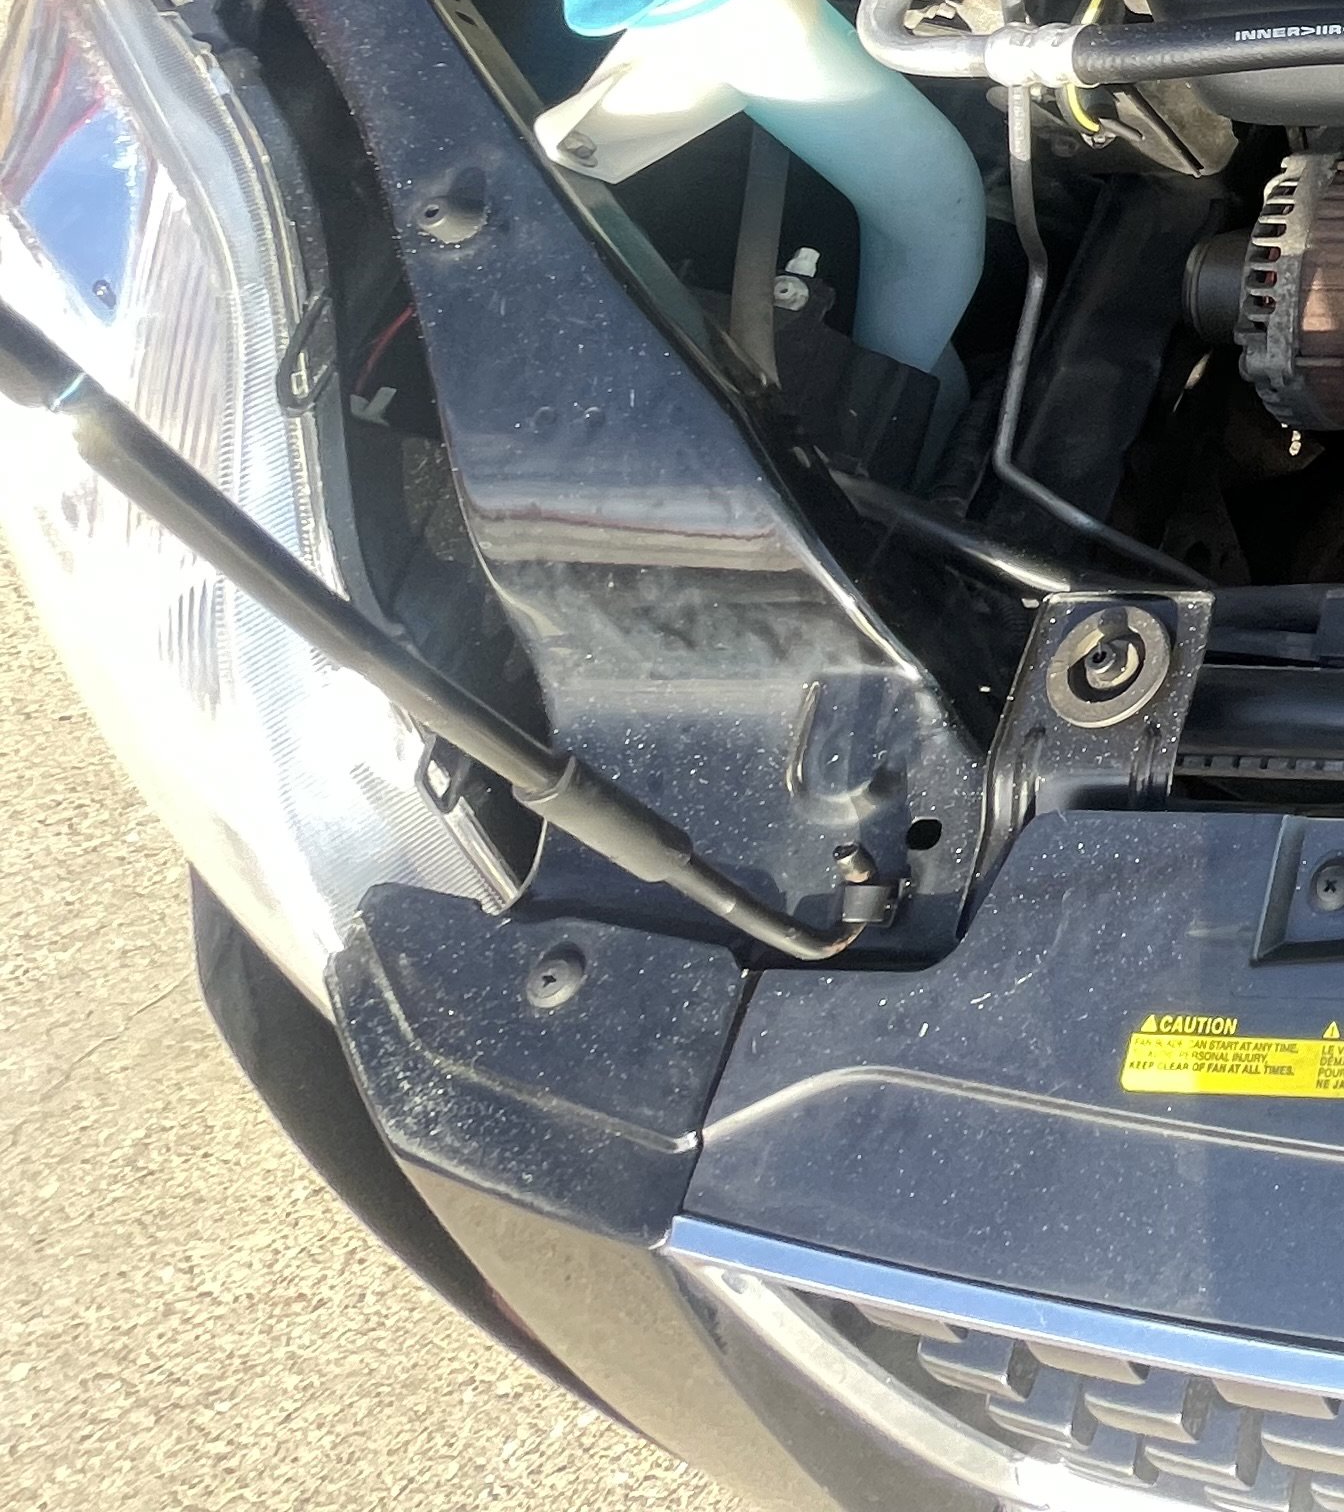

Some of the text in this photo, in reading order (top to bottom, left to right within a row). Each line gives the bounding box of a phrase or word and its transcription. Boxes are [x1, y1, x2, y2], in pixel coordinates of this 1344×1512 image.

[1159, 1015, 1238, 1035] CAUTION
[1208, 1040, 1239, 1051] START
[1240, 1041, 1253, 1051] AT
[1253, 1041, 1273, 1053] ANY
[1322, 1045, 1335, 1055] LE
[1192, 1063, 1206, 1072] OF
[1206, 1063, 1227, 1074] FAN
[1227, 1064, 1241, 1074] AT
[1242, 1065, 1261, 1075] ALL
[1316, 1079, 1330, 1089] NE
